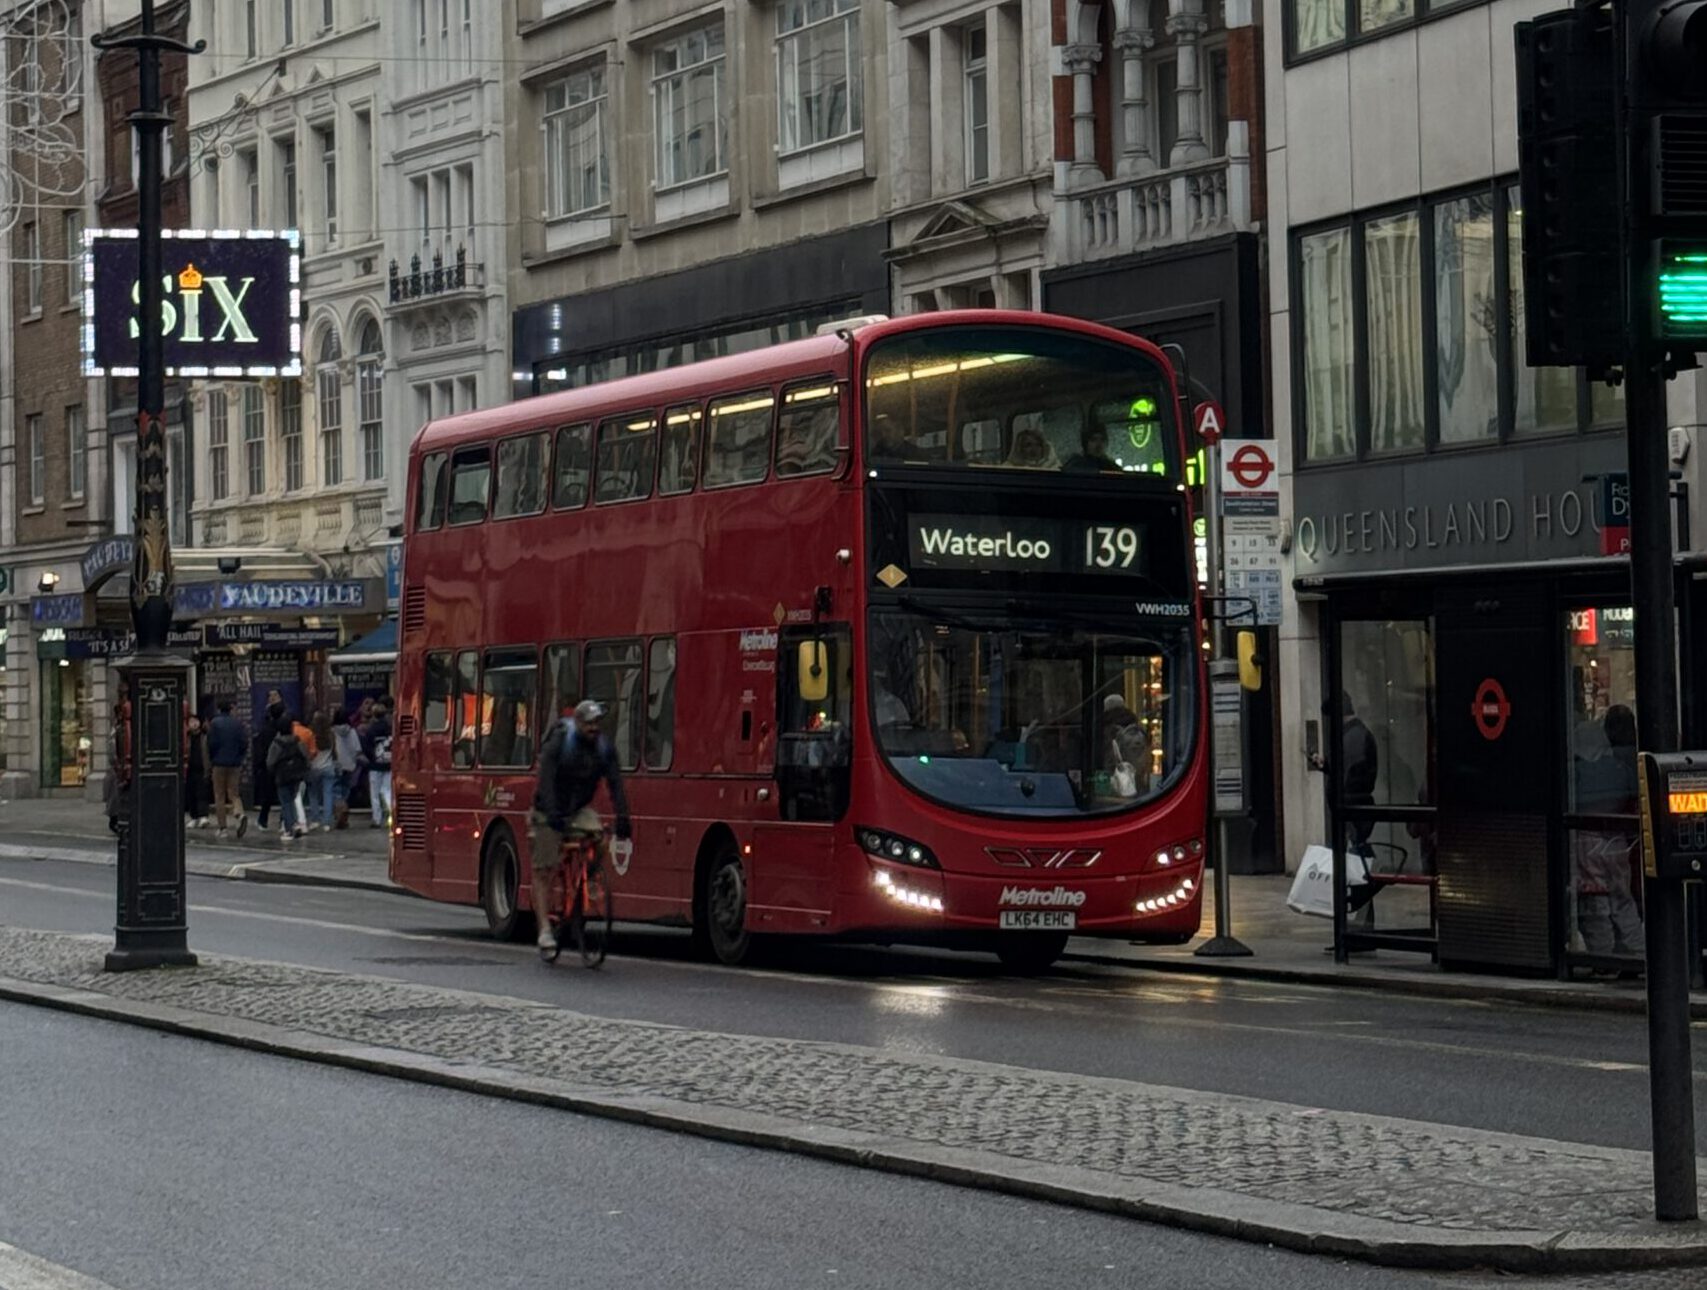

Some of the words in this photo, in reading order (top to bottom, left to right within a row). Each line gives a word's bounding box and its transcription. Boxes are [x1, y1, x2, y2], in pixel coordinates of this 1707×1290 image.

[129, 275, 258, 343] SIX
[1199, 407, 1220, 432] A
[1298, 498, 1512, 564] QUEENSLAND
[1532, 490, 1602, 537] HOU
[920, 528, 1051, 559] Waterloo
[1086, 527, 1137, 567] 139
[223, 584, 362, 607] VAUDEVILLE
[1135, 602, 1190, 616] VWH2035
[999, 886, 1086, 907] Metroline
[1005, 911, 1040, 926] LK64
[1043, 911, 1069, 926] EHC
